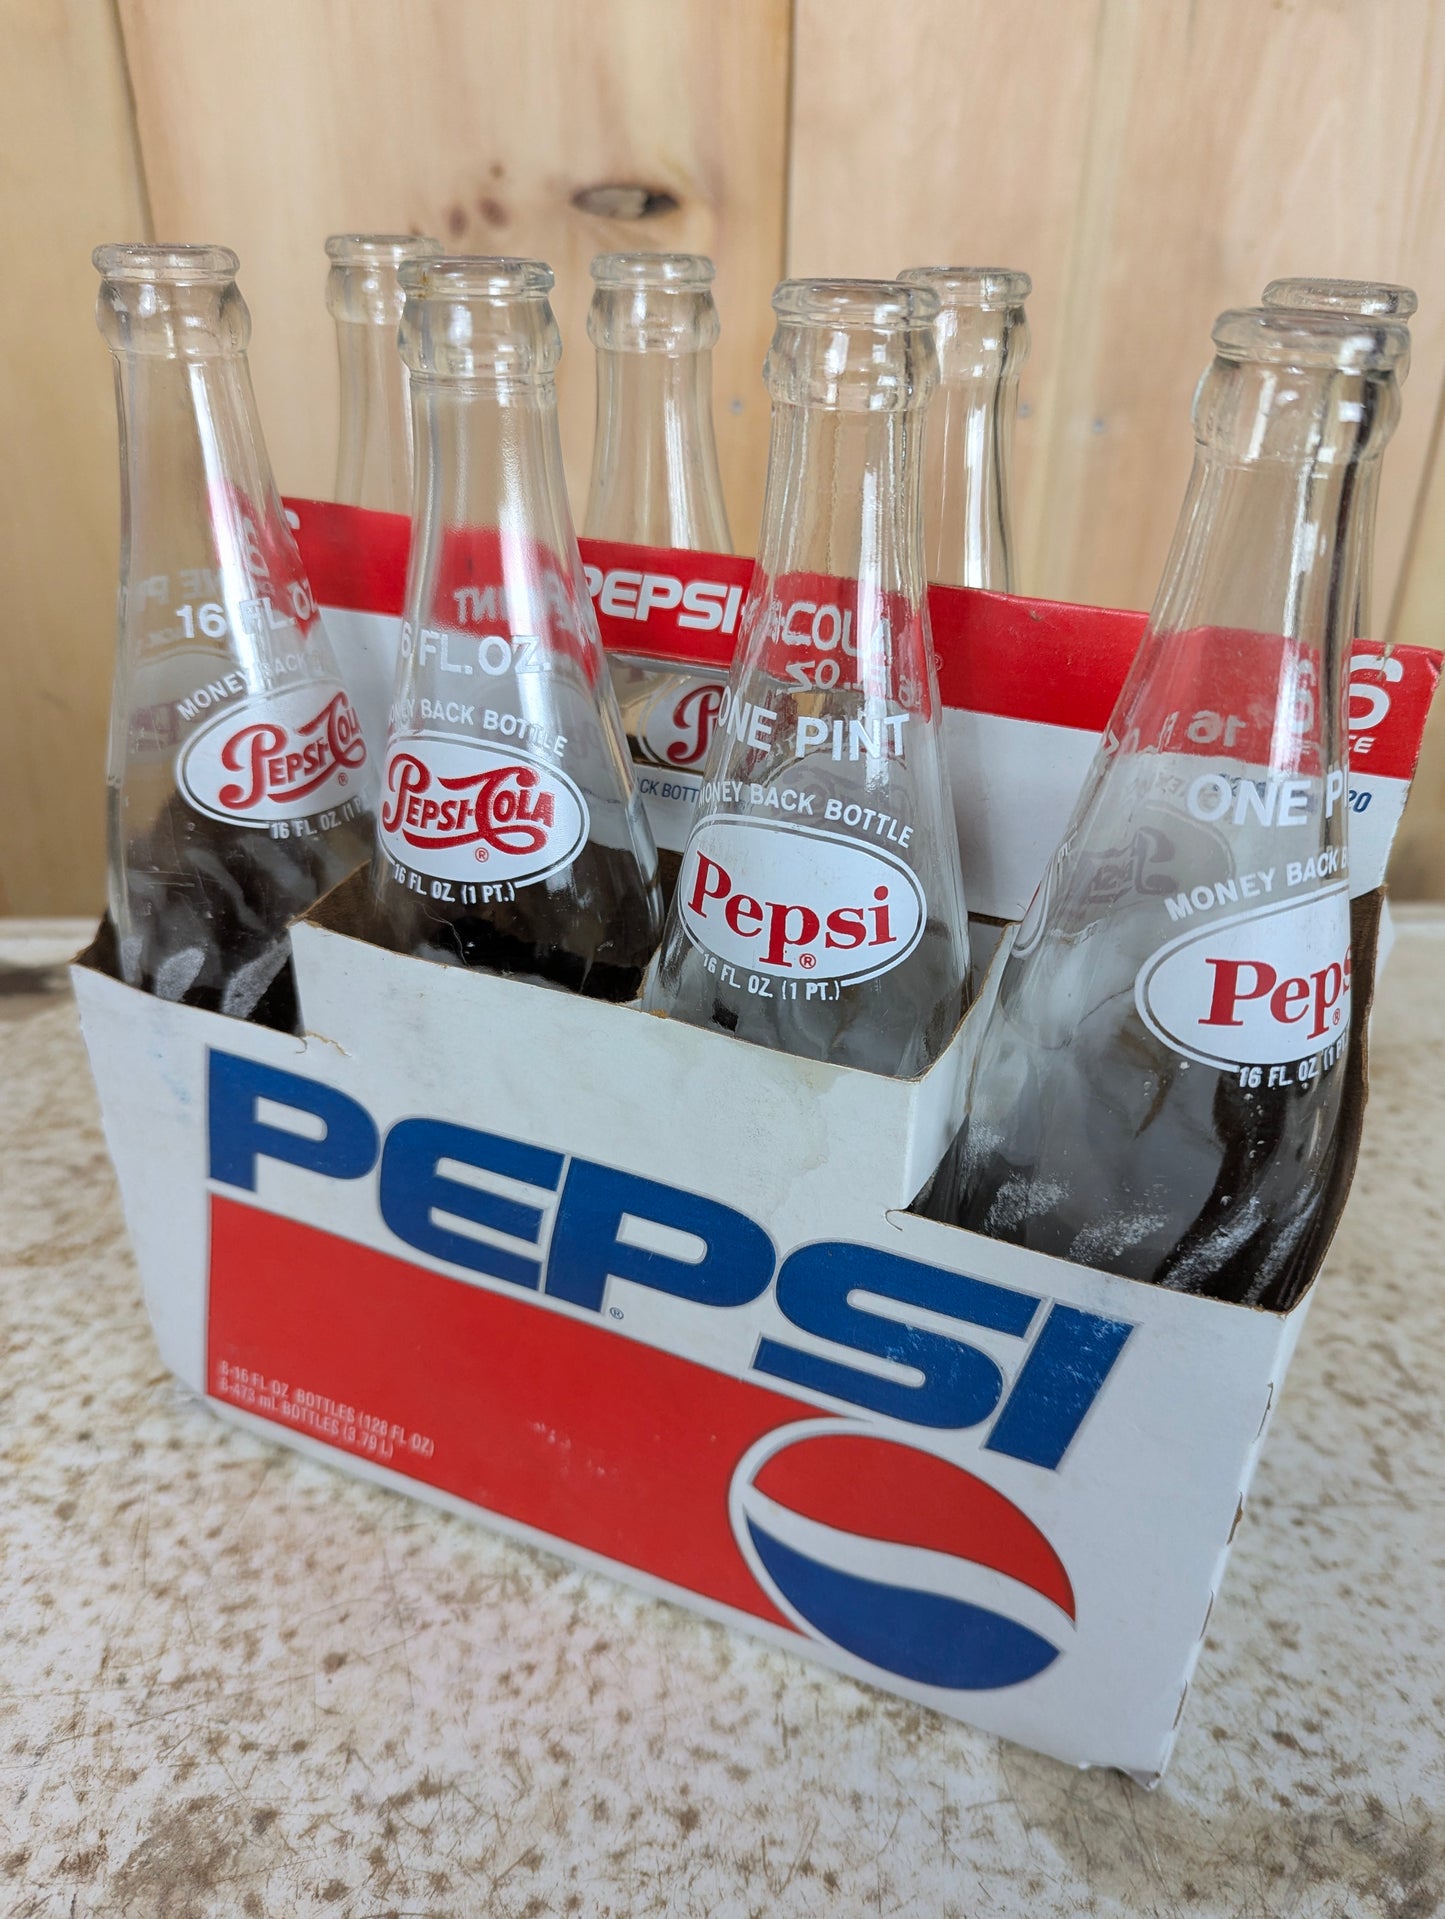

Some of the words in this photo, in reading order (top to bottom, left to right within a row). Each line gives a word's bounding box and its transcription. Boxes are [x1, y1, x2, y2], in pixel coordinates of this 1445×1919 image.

[176, 603, 228, 638] 16
[419, 629, 474, 676] FL.
[478, 635, 552, 677] OZ.
[176, 668, 250, 722] MONEY
[420, 698, 475, 726] BACK
[483, 709, 569, 758] BOTTLE
[718, 685, 778, 752] ONE
[794, 712, 911, 762] PINT
[661, 782, 700, 804] BOTT
[750, 783, 816, 816] BACK
[824, 798, 914, 849] BOTTLE
[1187, 773, 1312, 828] ONE
[271, 821, 290, 840] 16
[393, 863, 407, 885] 16
[1164, 867, 1276, 922] MONEY
[1286, 845, 1339, 888] BACK
[688, 850, 897, 968] Pepsi
[703, 953, 718, 975] 16
[782, 979, 797, 1001] (1
[806, 979, 840, 1001] PT.)
[1239, 1066, 1263, 1089] 16
[206, 1045, 1140, 1472] PEPSI
[220, 1360, 249, 1384] 8-16
[296, 1388, 355, 1424] BOTTLES
[358, 1411, 389, 1437] (128
[282, 1400, 340, 1436] BOTTLES
